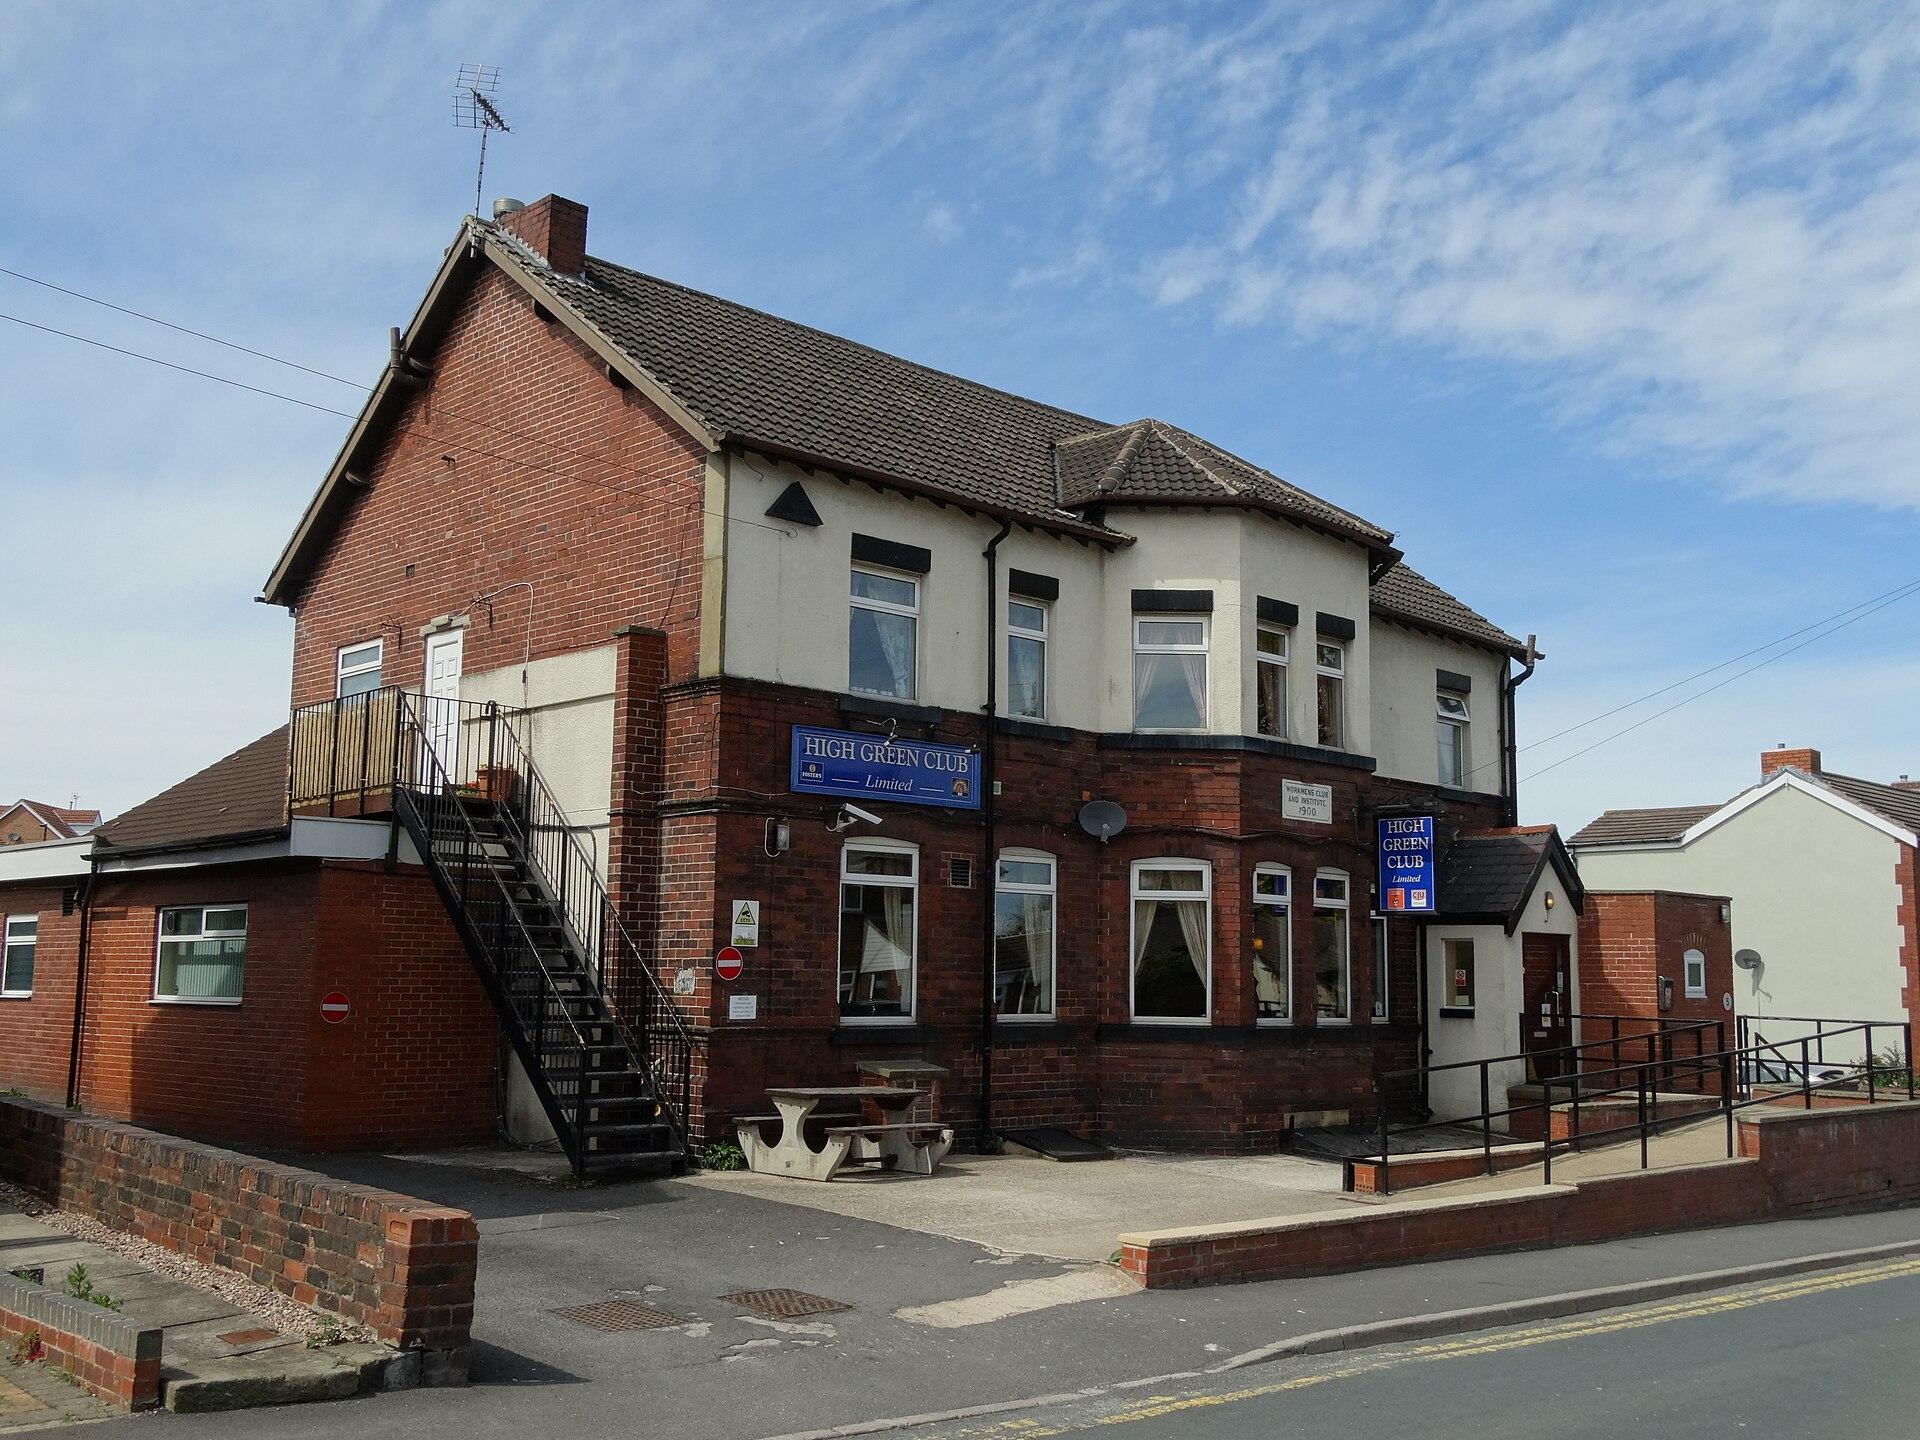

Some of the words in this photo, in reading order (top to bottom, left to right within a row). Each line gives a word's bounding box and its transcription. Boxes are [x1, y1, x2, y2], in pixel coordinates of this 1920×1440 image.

[804, 737, 855, 760] HIGH
[860, 744, 919, 767] GREEN
[924, 751, 969, 773] CLUB
[865, 775, 913, 791] Limited
[1316, 790, 1329, 798] CLUB
[1288, 795, 1299, 803] AND
[1301, 797, 1327, 807] INSTITUTE
[1299, 806, 1317, 816] 1900
[1387, 820, 1425, 833] HIGH
[1383, 837, 1429, 851] GREEN
[1387, 855, 1424, 868] CLUB
